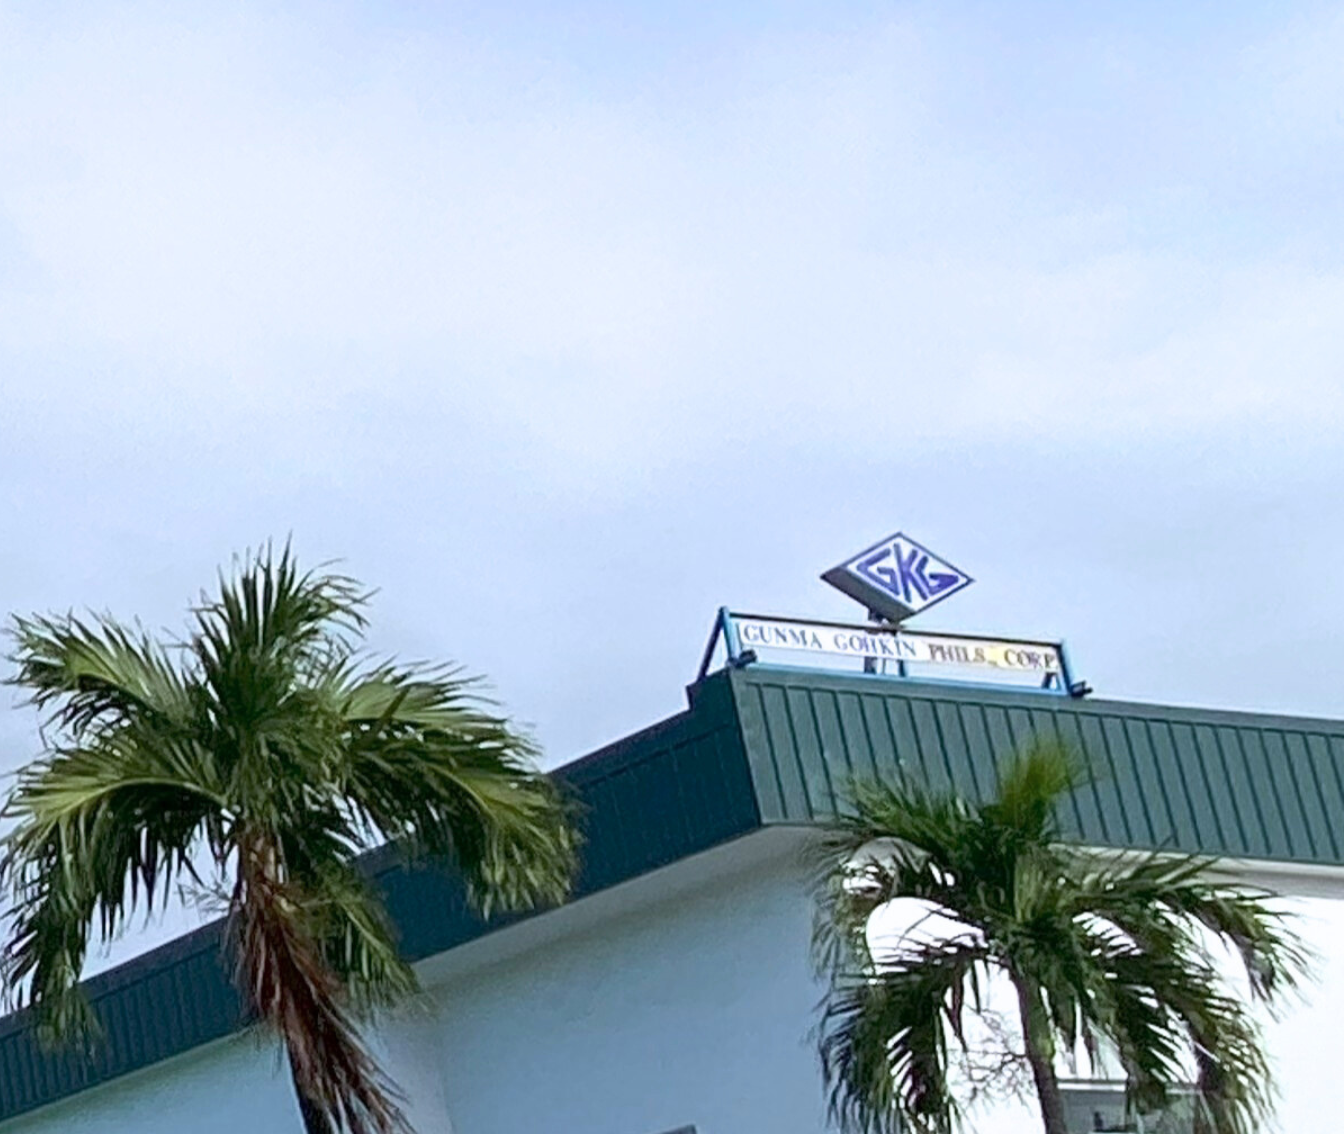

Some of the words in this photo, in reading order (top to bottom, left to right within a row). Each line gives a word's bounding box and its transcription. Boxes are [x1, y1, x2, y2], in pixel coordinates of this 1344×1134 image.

[856, 542, 959, 603] GKG
[743, 623, 823, 650] GUNMA
[833, 632, 917, 657] GOHKIN
